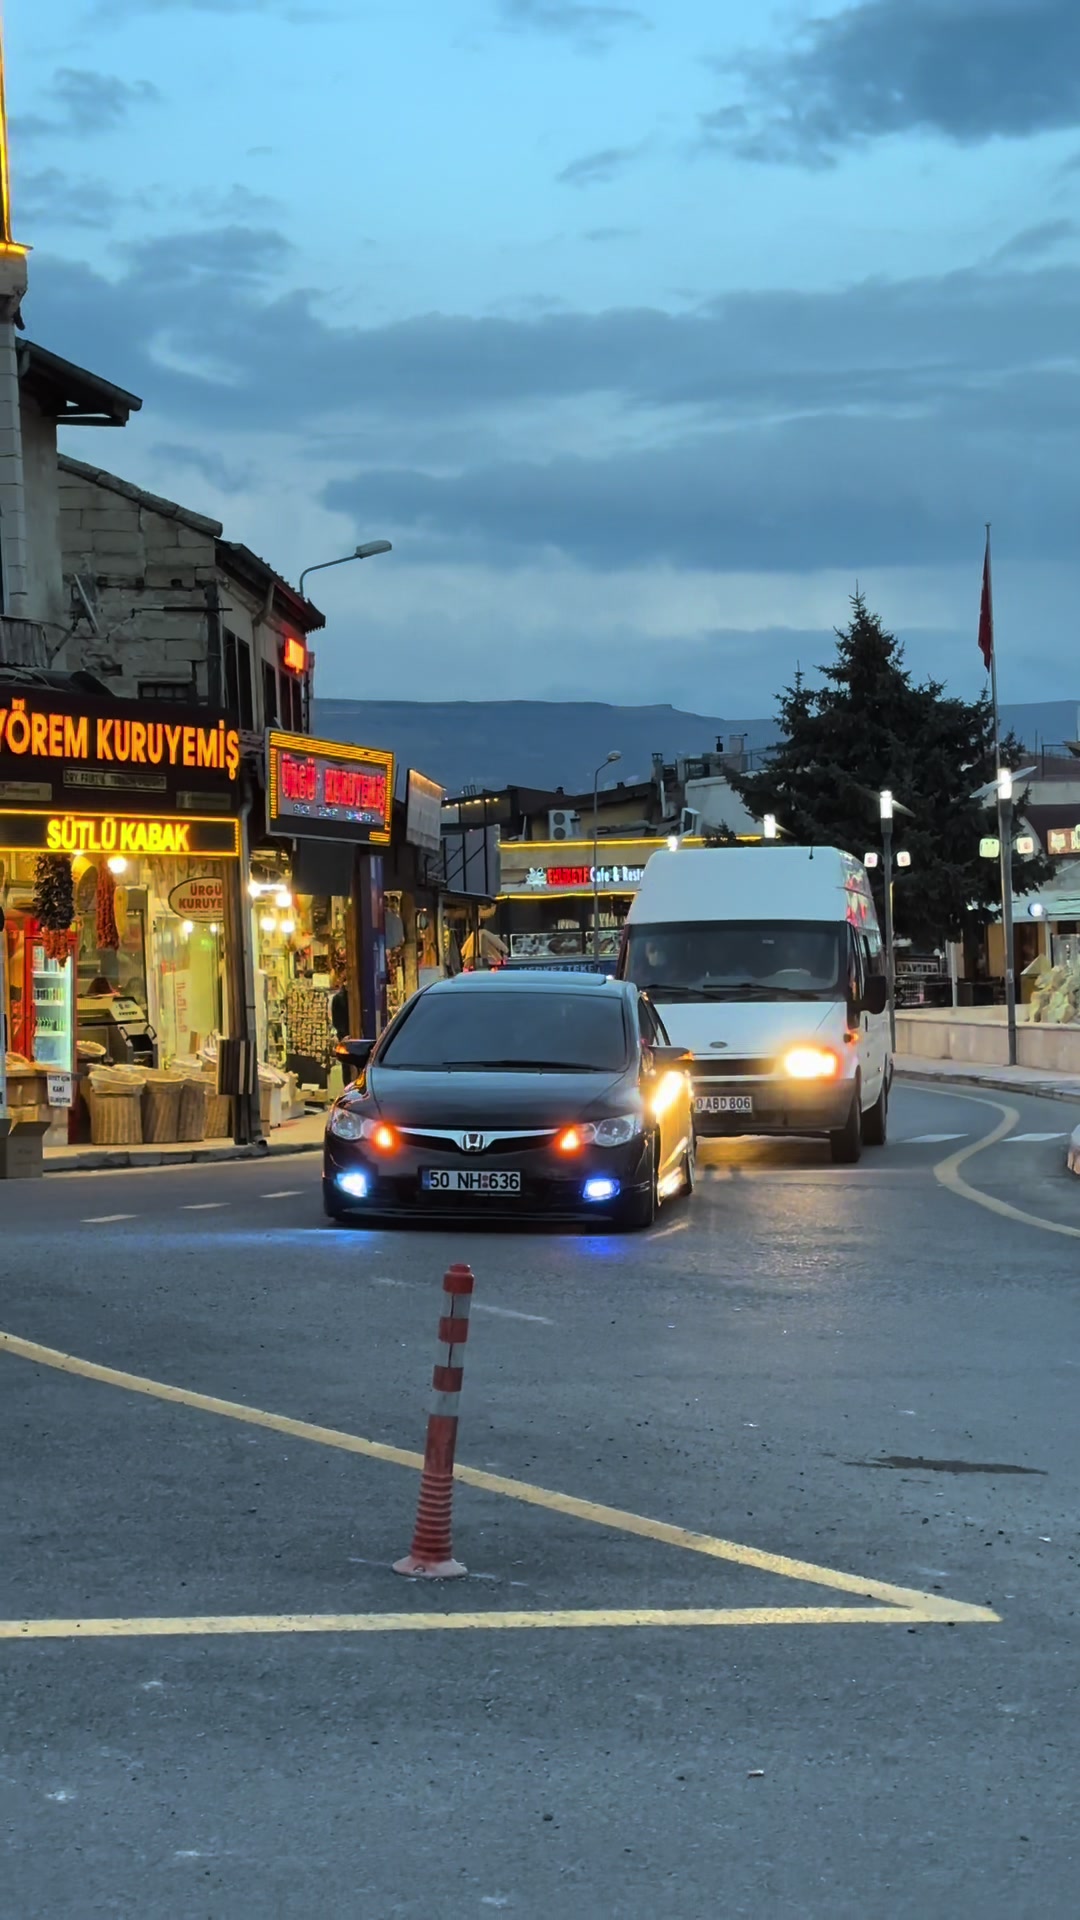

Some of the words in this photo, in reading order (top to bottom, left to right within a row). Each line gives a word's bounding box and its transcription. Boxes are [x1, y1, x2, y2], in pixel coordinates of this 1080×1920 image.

[97, 718, 239, 780] KURUYEMİŞ
[47, 816, 116, 849] SÜTLÜ
[120, 822, 189, 851] KABAK
[706, 1098, 727, 1110] ABD
[729, 1097, 751, 1109] 806
[430, 1172, 449, 1188] 50
[457, 1172, 481, 1189] NH
[489, 1173, 519, 1189] 636
